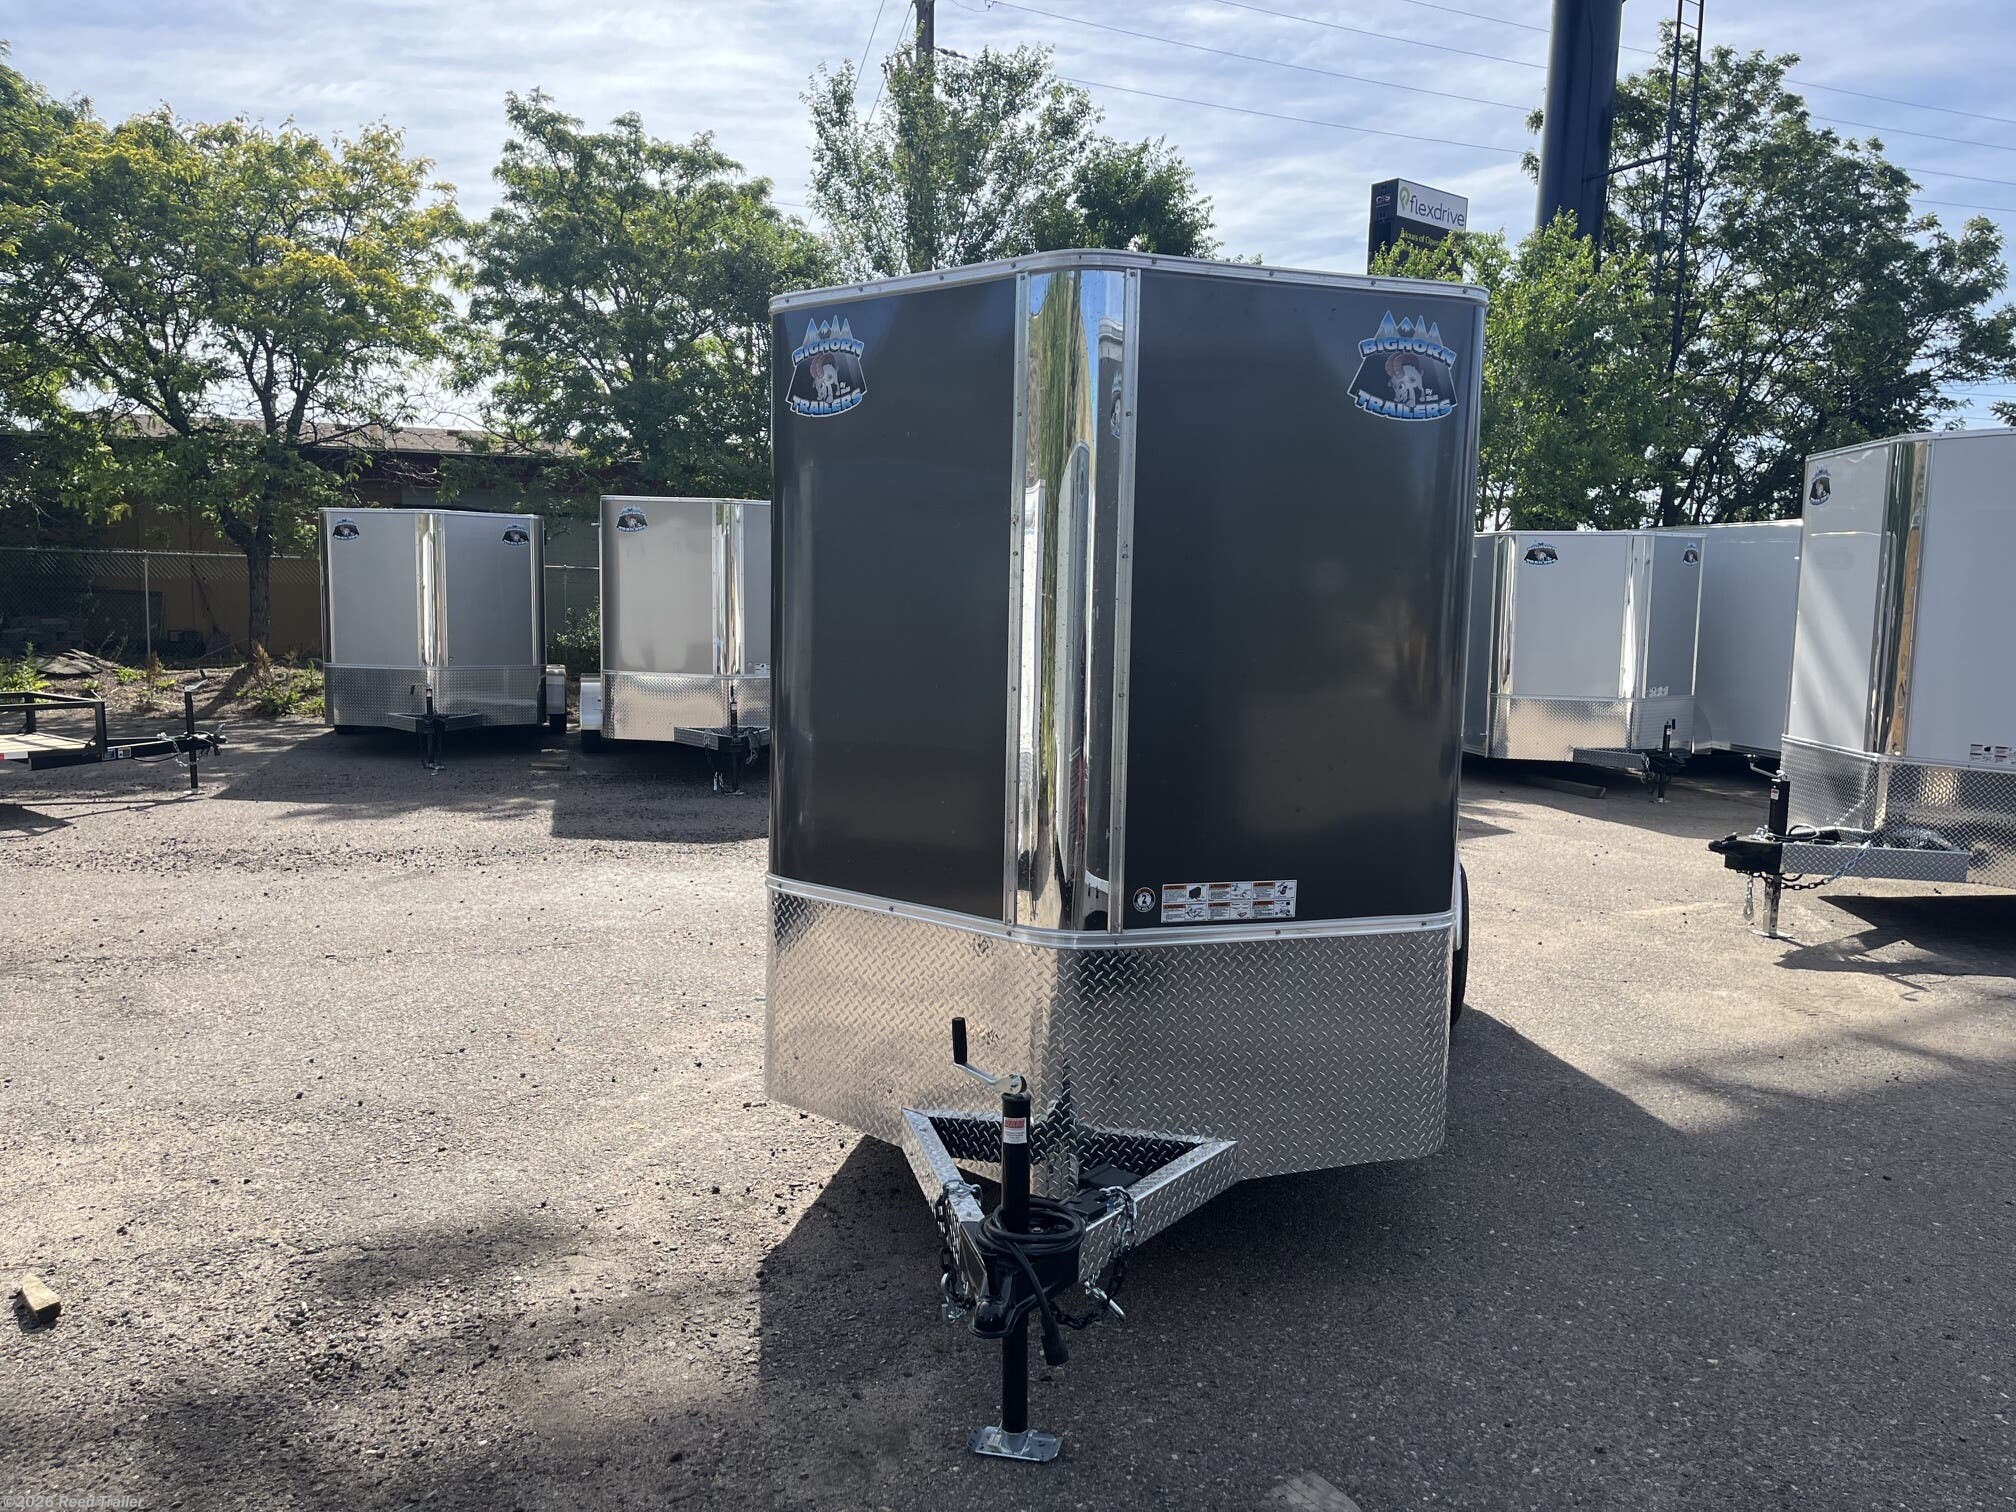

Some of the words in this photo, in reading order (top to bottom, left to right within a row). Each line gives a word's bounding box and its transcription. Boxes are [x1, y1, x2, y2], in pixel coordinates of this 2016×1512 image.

[1409, 194, 1465, 227] flexdrive
[792, 338, 864, 365] BIGHORN
[1361, 336, 1456, 366] BIGHORN
[791, 388, 863, 416] TRAILERS
[1358, 389, 1453, 420] TRAILERS
